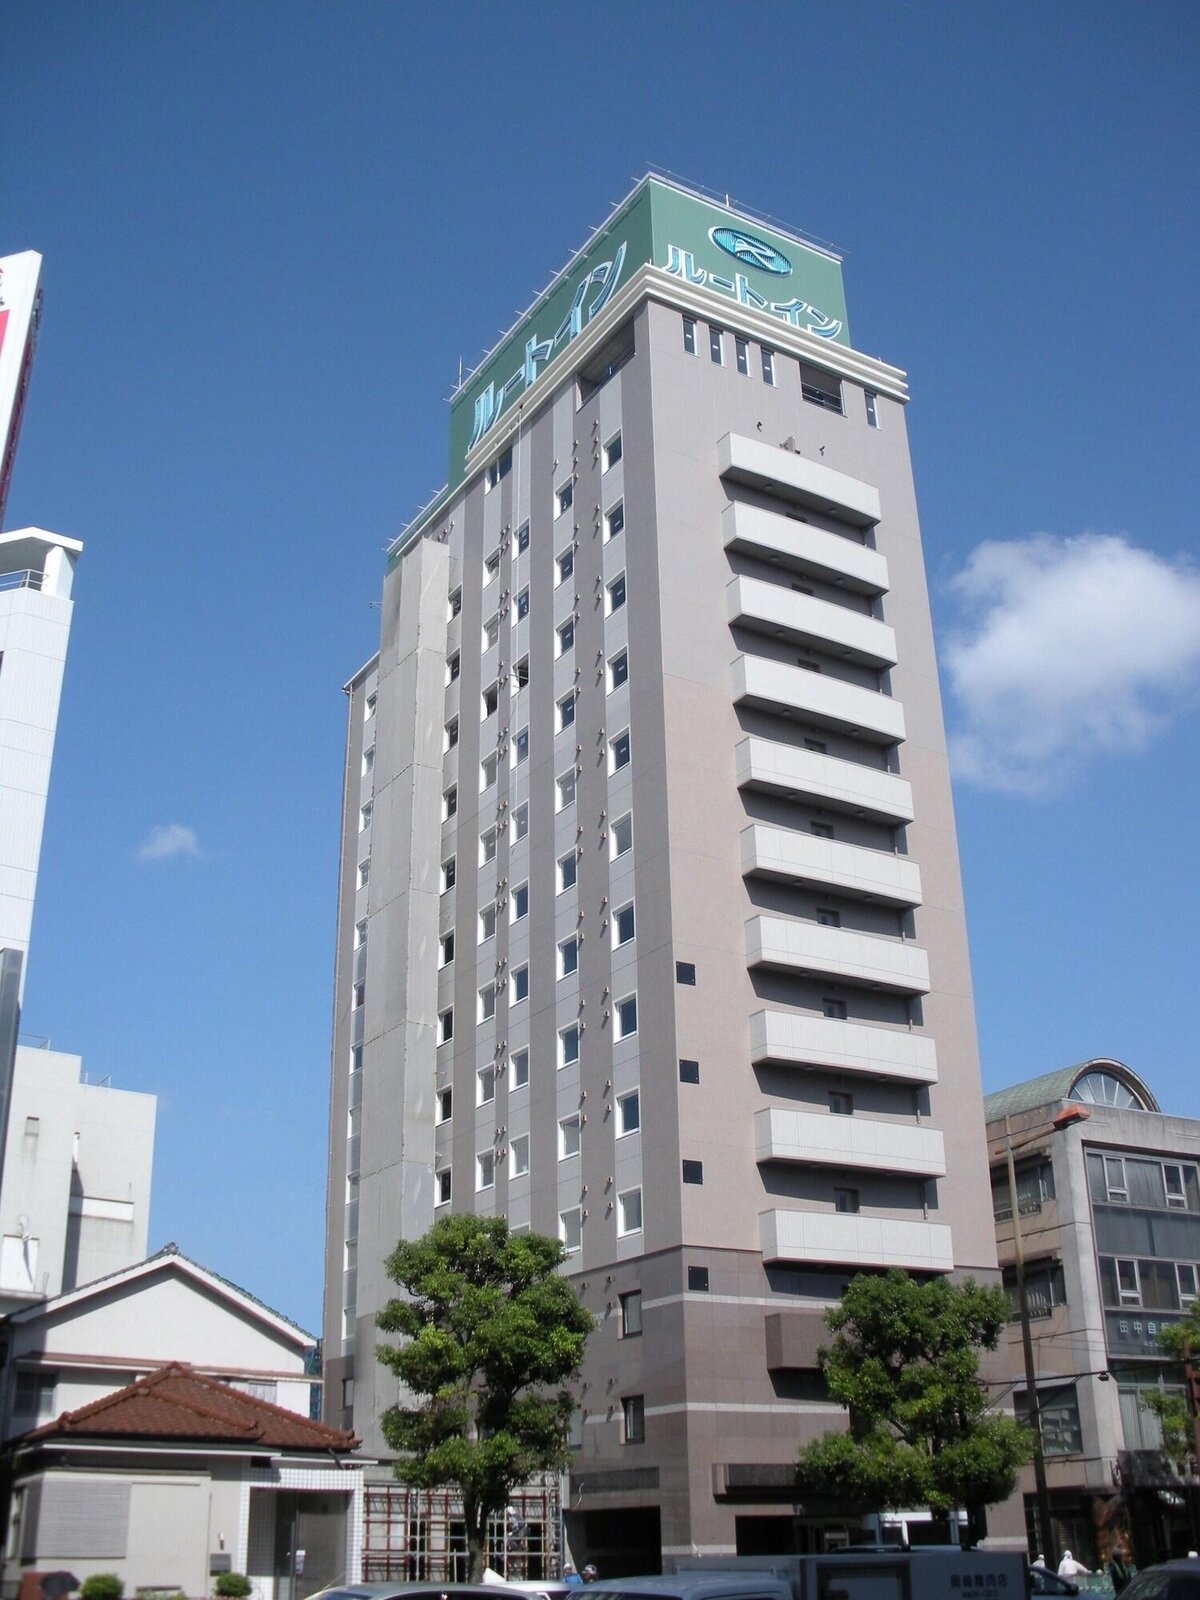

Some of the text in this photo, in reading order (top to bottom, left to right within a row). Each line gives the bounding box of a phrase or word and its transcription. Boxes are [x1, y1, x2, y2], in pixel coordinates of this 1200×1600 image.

[467, 241, 628, 453] ルートイン
[661, 244, 843, 340] ルートイン
